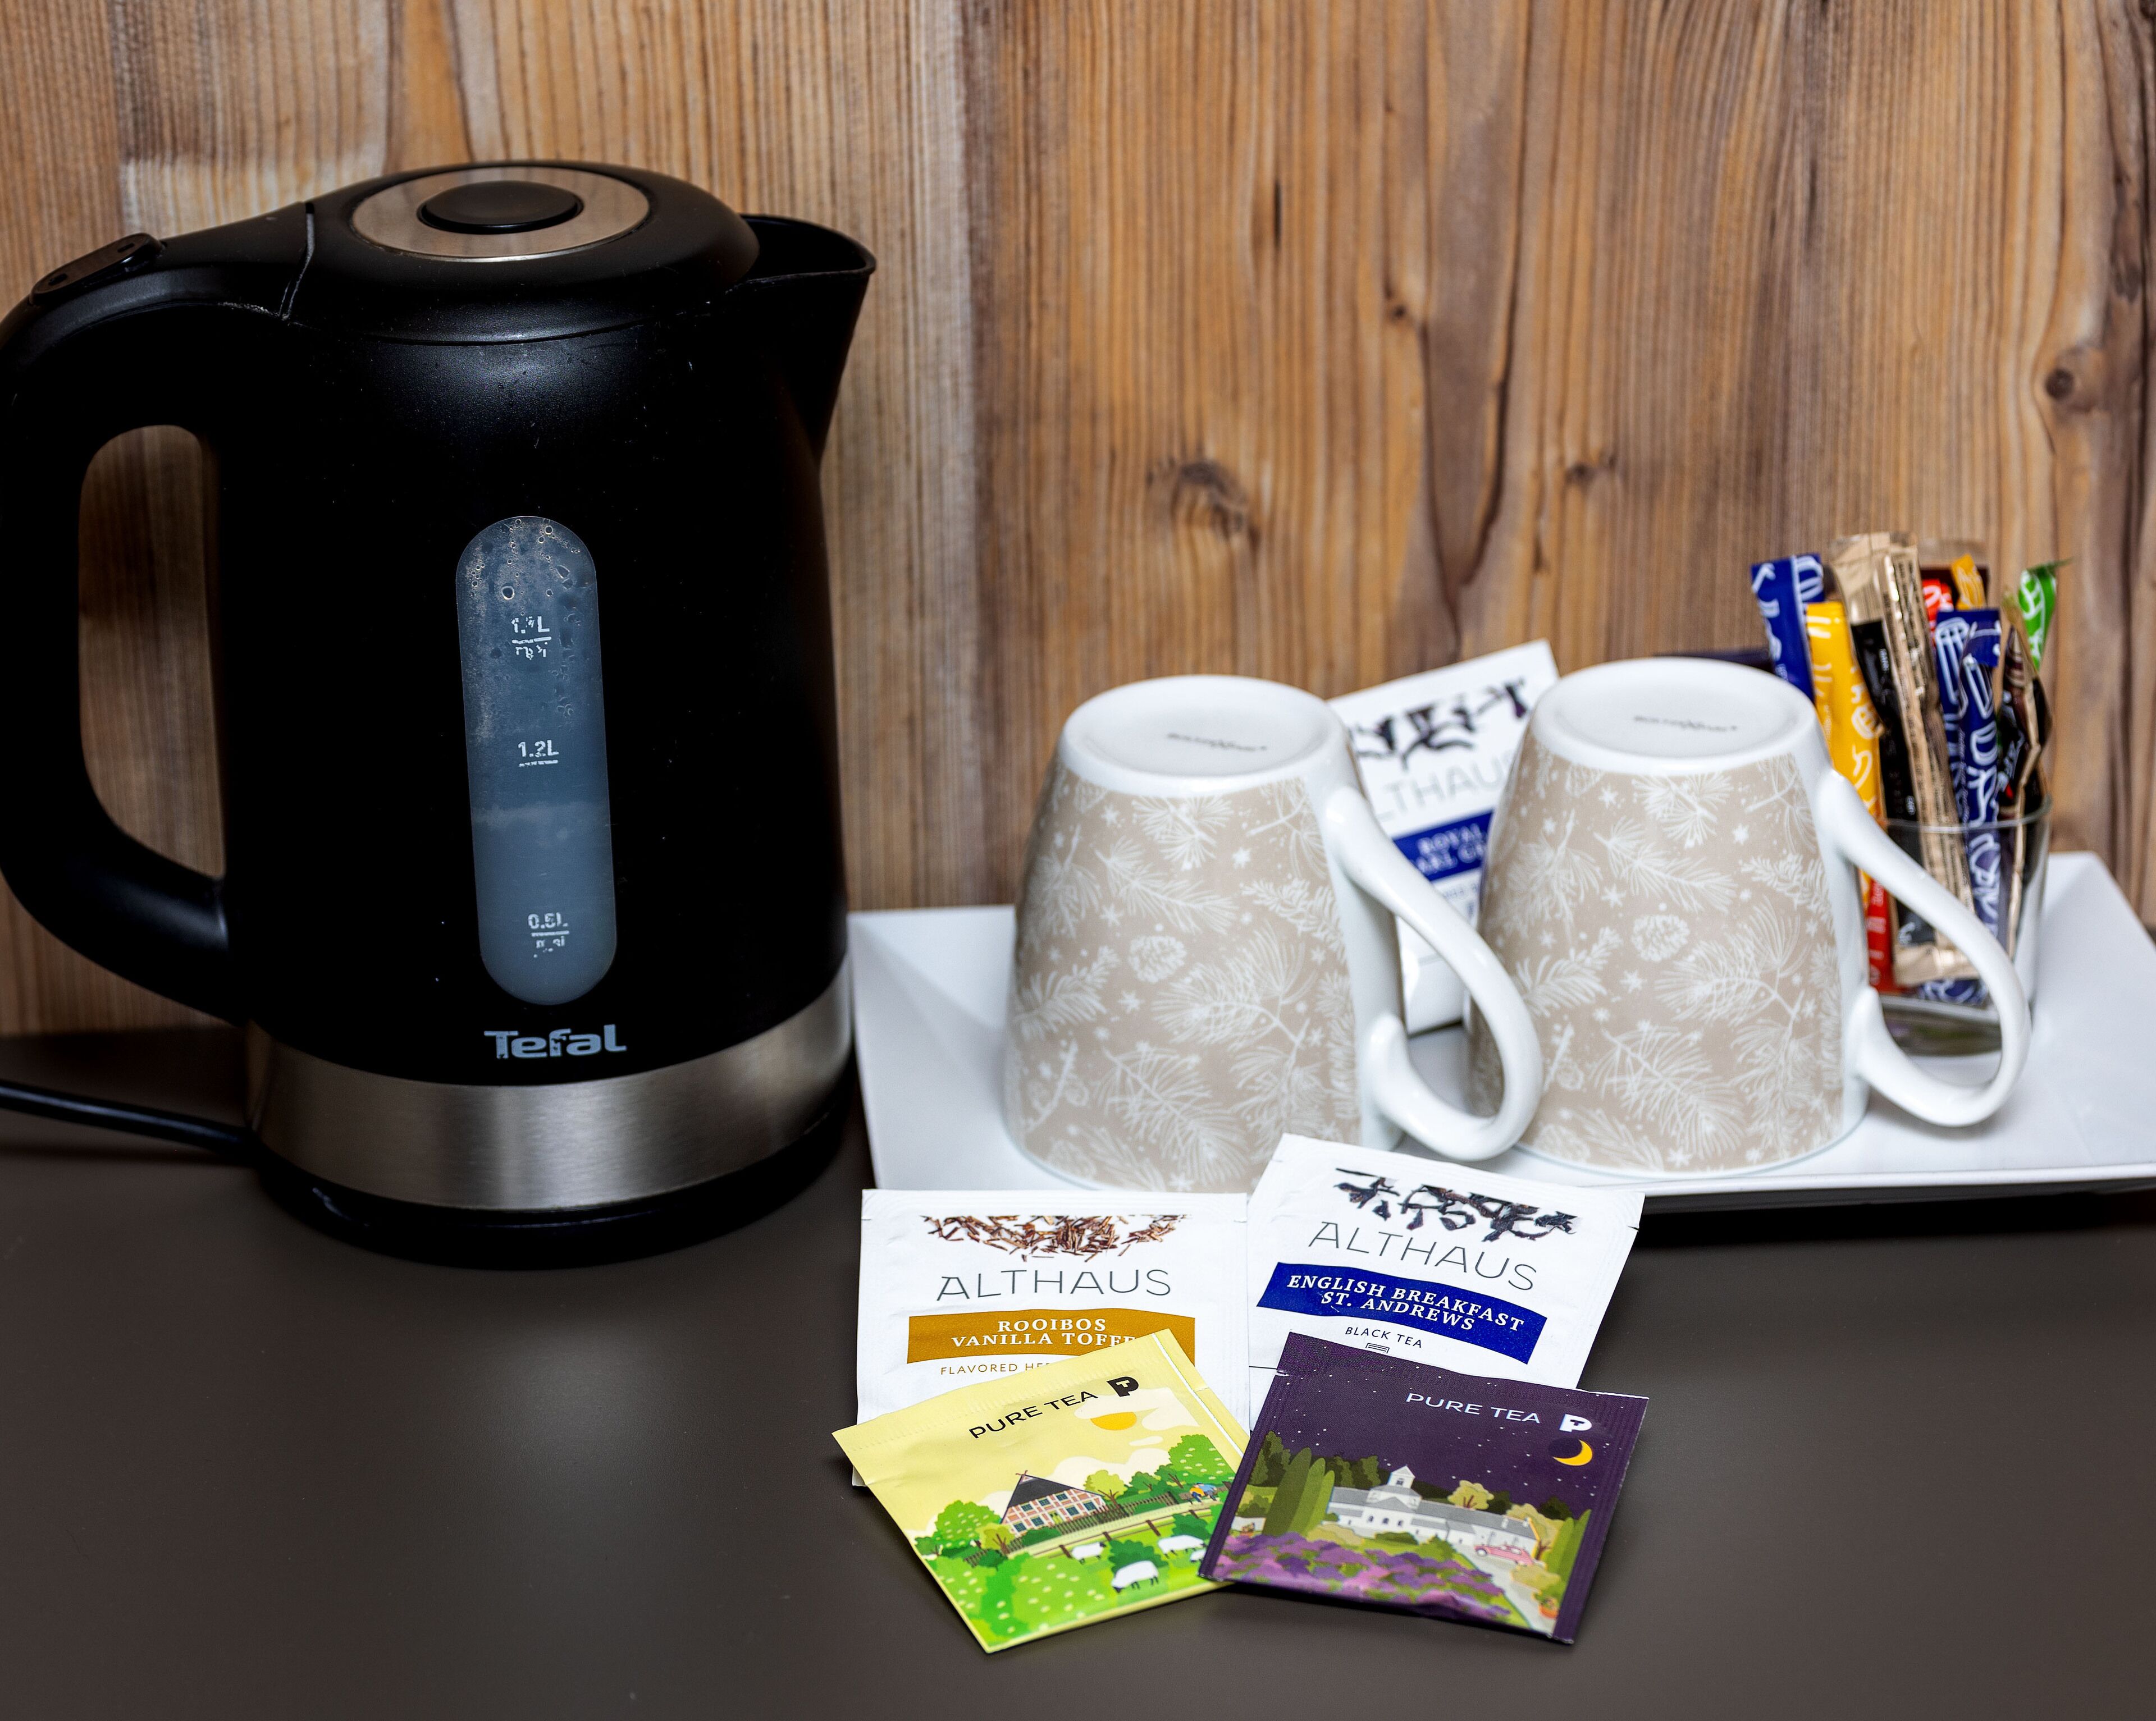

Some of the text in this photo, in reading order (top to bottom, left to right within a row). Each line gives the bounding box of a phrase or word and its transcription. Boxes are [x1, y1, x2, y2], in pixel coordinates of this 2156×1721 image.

[518, 739, 560, 758] 1.2L
[483, 1023, 628, 1059] Tefal
[1308, 1221, 1537, 1290] ALTHAUS
[937, 1269, 1171, 1301] ALTHAUS
[1286, 1275, 1525, 1331] ENGLISH BREAKFAST
[1321, 1291, 1476, 1331] ST. ANDREWS
[951, 1333, 1053, 1348] VANILLA
[997, 1318, 1106, 1333] ROOIBOS
[1345, 1326, 1423, 1348] BLACK TEA
[940, 1363, 1018, 1375] FLAVORED
[969, 1390, 1099, 1439] PURE TEA
[1405, 1392, 1541, 1424] PURE TEA
